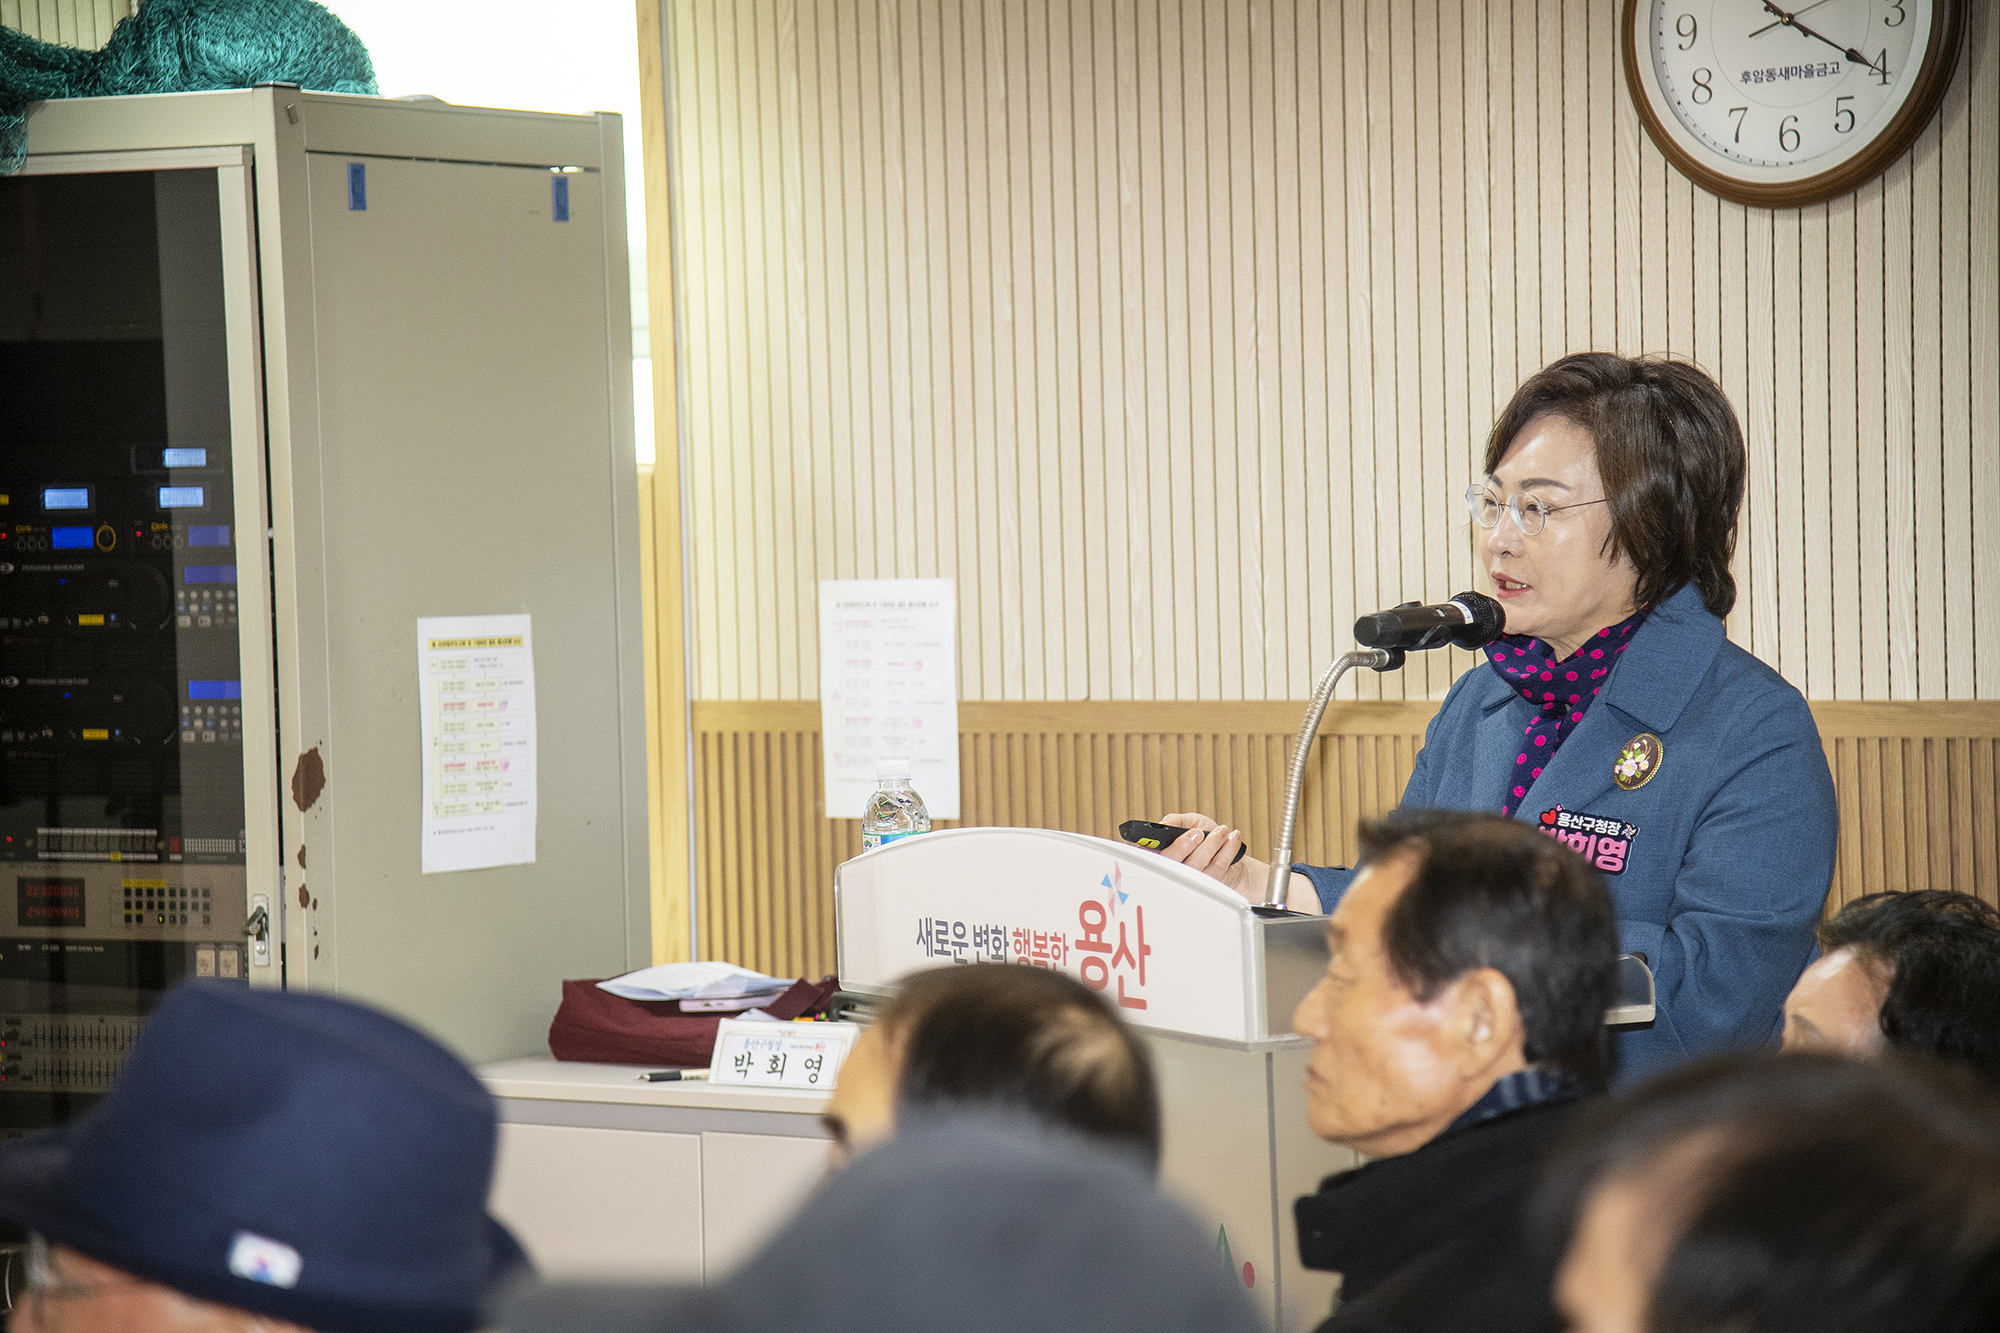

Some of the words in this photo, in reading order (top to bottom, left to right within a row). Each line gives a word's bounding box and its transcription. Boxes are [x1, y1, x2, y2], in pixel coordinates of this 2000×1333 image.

[1676, 13, 1697, 50] 9
[1884, 0, 1905, 27] 3
[1691, 67, 1713, 104] 8
[1739, 61, 1841, 84] 후암동새마을금고
[1868, 48, 1892, 86] 4
[1728, 106, 1748, 143] 7
[1779, 115, 1801, 152] 6
[1834, 96, 1856, 134] 5
[1557, 812, 1622, 836] 용산구청장
[916, 917, 969, 965] 새로운
[973, 923, 1009, 965] 변화
[1075, 900, 1151, 1010] 용산
